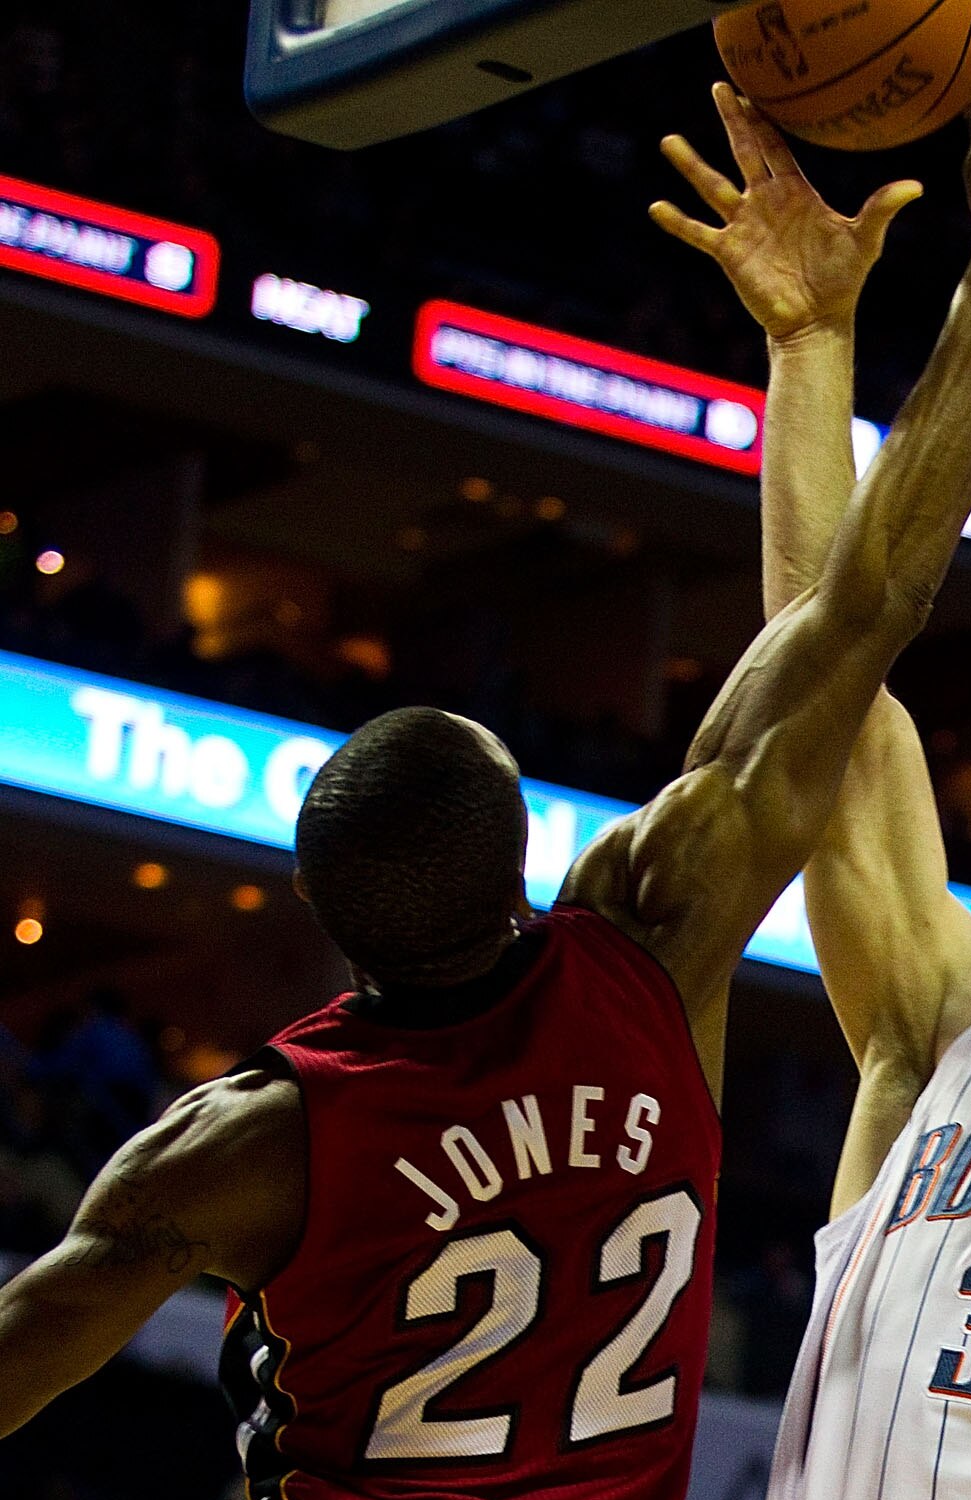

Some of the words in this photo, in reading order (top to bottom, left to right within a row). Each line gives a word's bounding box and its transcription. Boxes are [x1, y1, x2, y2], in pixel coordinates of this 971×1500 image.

[73, 687, 248, 808] The
[394, 1085, 661, 1231] JONES
[363, 1189, 702, 1460] 22
